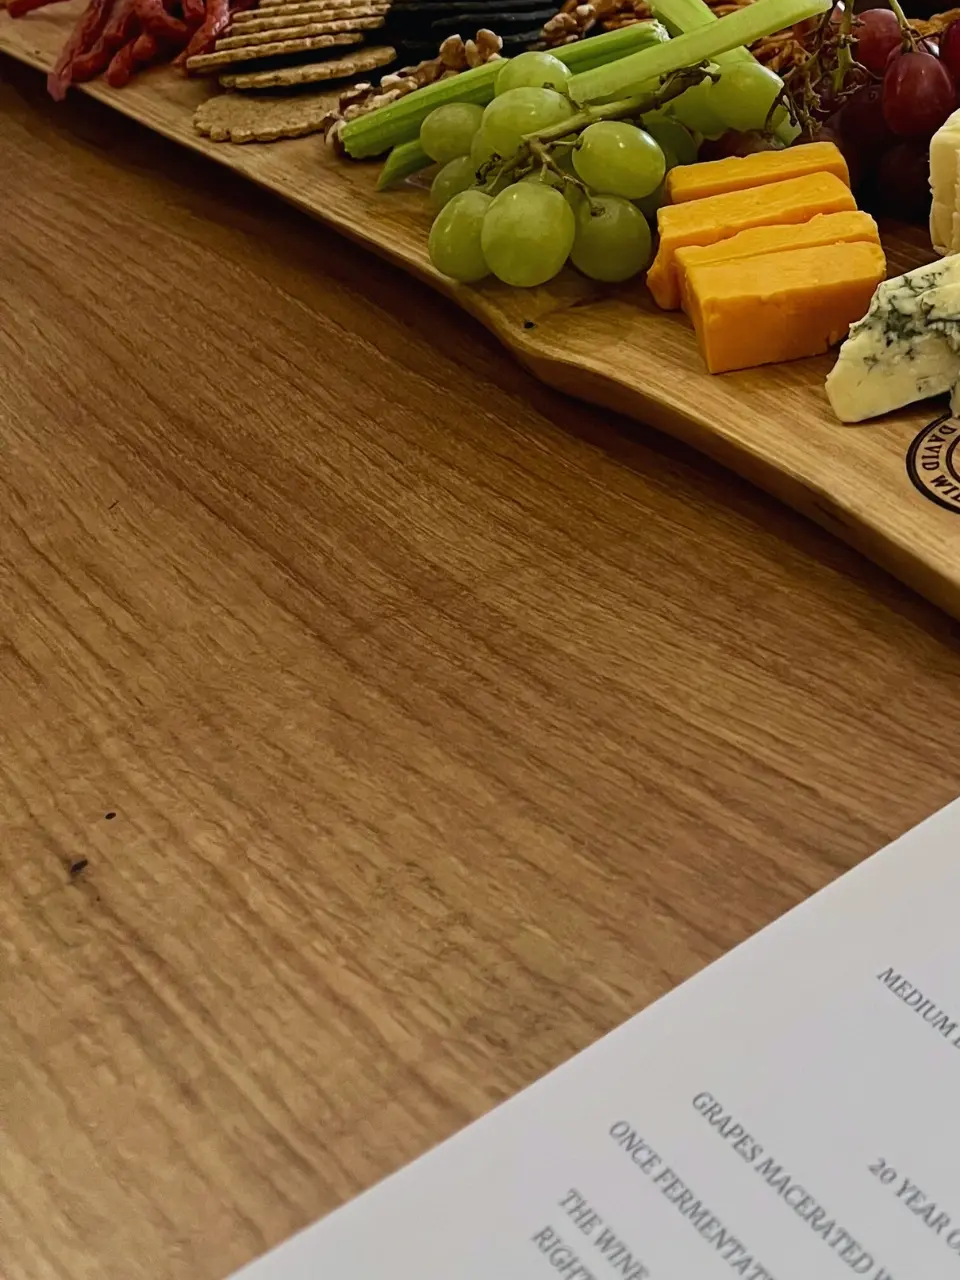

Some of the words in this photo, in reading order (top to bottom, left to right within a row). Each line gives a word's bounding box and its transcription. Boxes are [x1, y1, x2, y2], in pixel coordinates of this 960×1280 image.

[921, 424, 957, 471] DAVID
[876, 967, 959, 1039] MEDIUM
[609, 1120, 661, 1175] ONCE
[558, 1188, 602, 1236] THE
[692, 1091, 763, 1163] GRAPES
[754, 1157, 874, 1274] MACERATED
[867, 1157, 897, 1185] 20
[895, 1177, 950, 1235] YEAR
